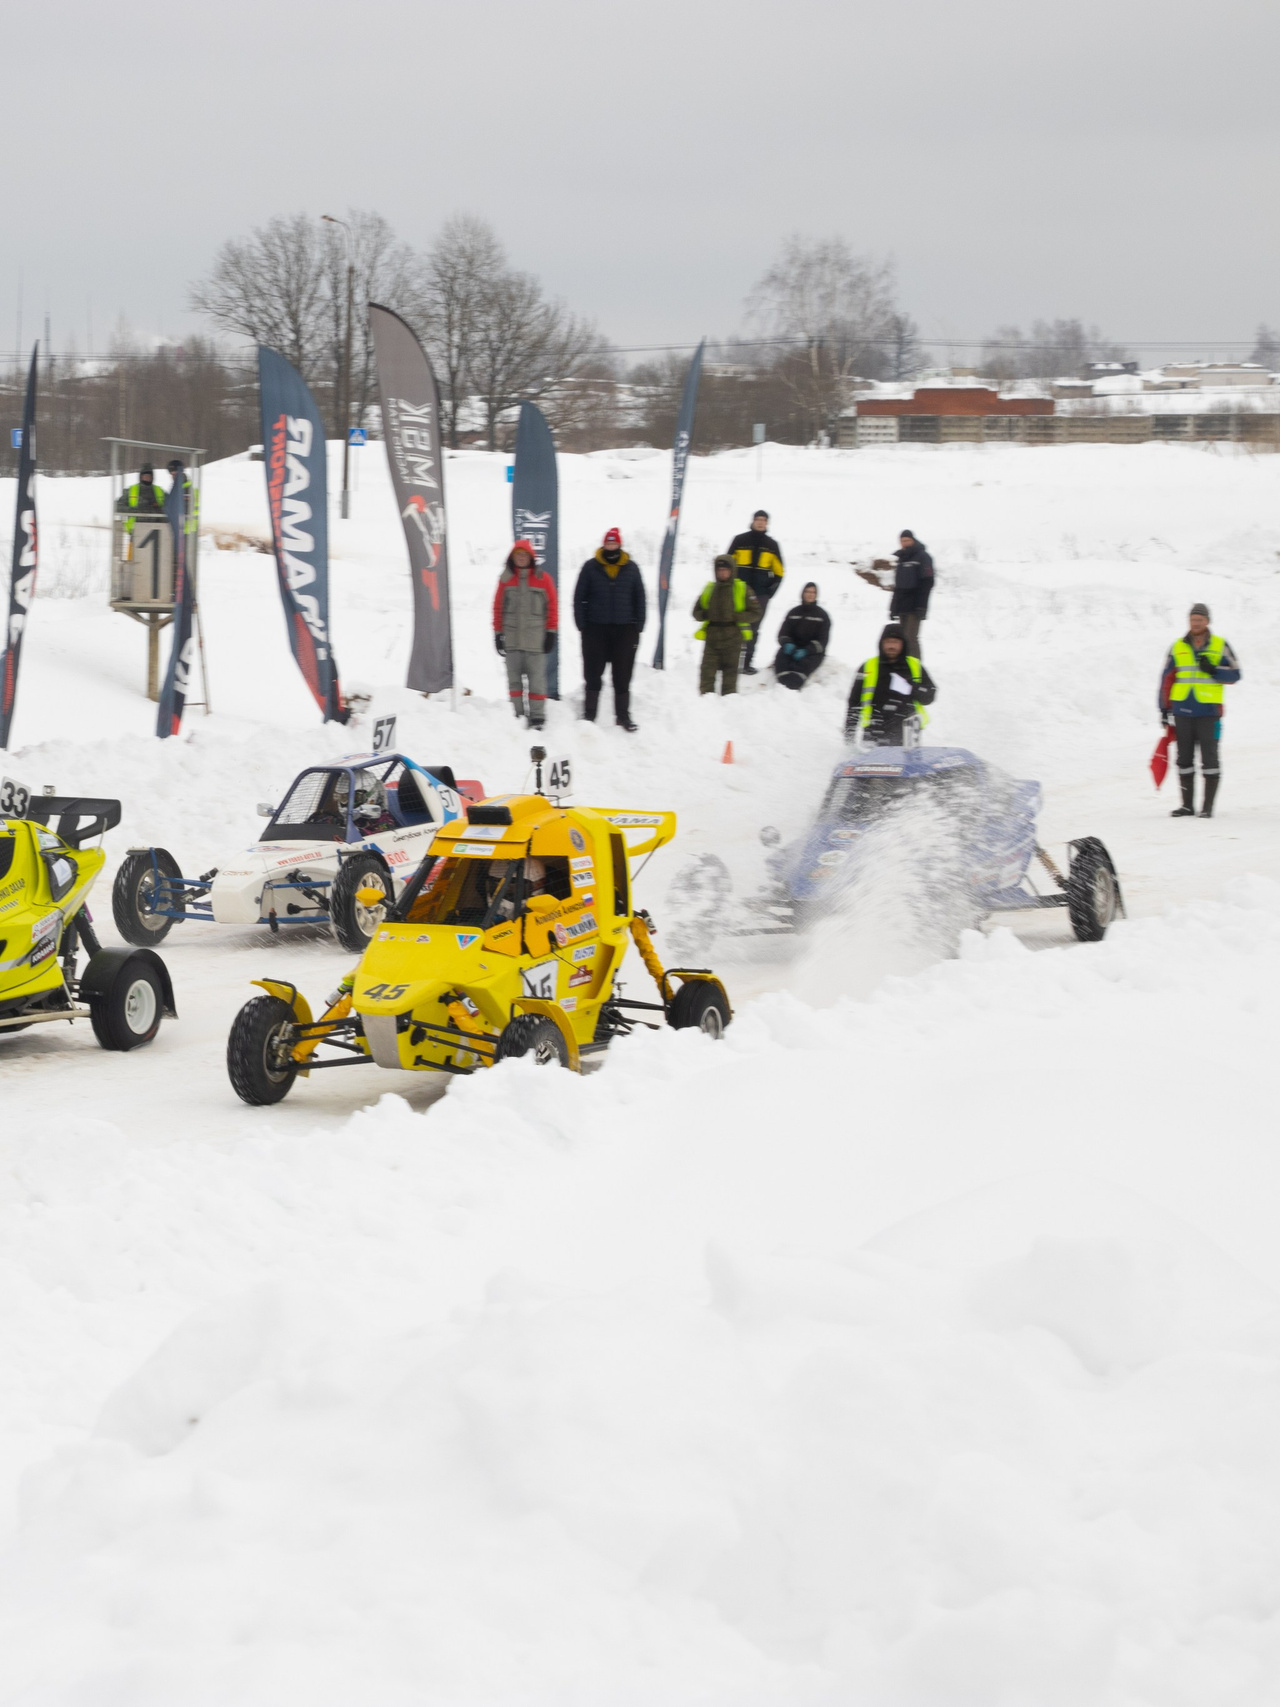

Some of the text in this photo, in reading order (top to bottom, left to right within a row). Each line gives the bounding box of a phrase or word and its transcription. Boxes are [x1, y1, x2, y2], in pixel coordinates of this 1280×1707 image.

[137, 529, 160, 599] 1
[373, 716, 397, 750] 57
[550, 759, 571, 790] 45
[1, 781, 28, 818] 33
[439, 789, 455, 809] 57
[363, 983, 410, 1000] 45
